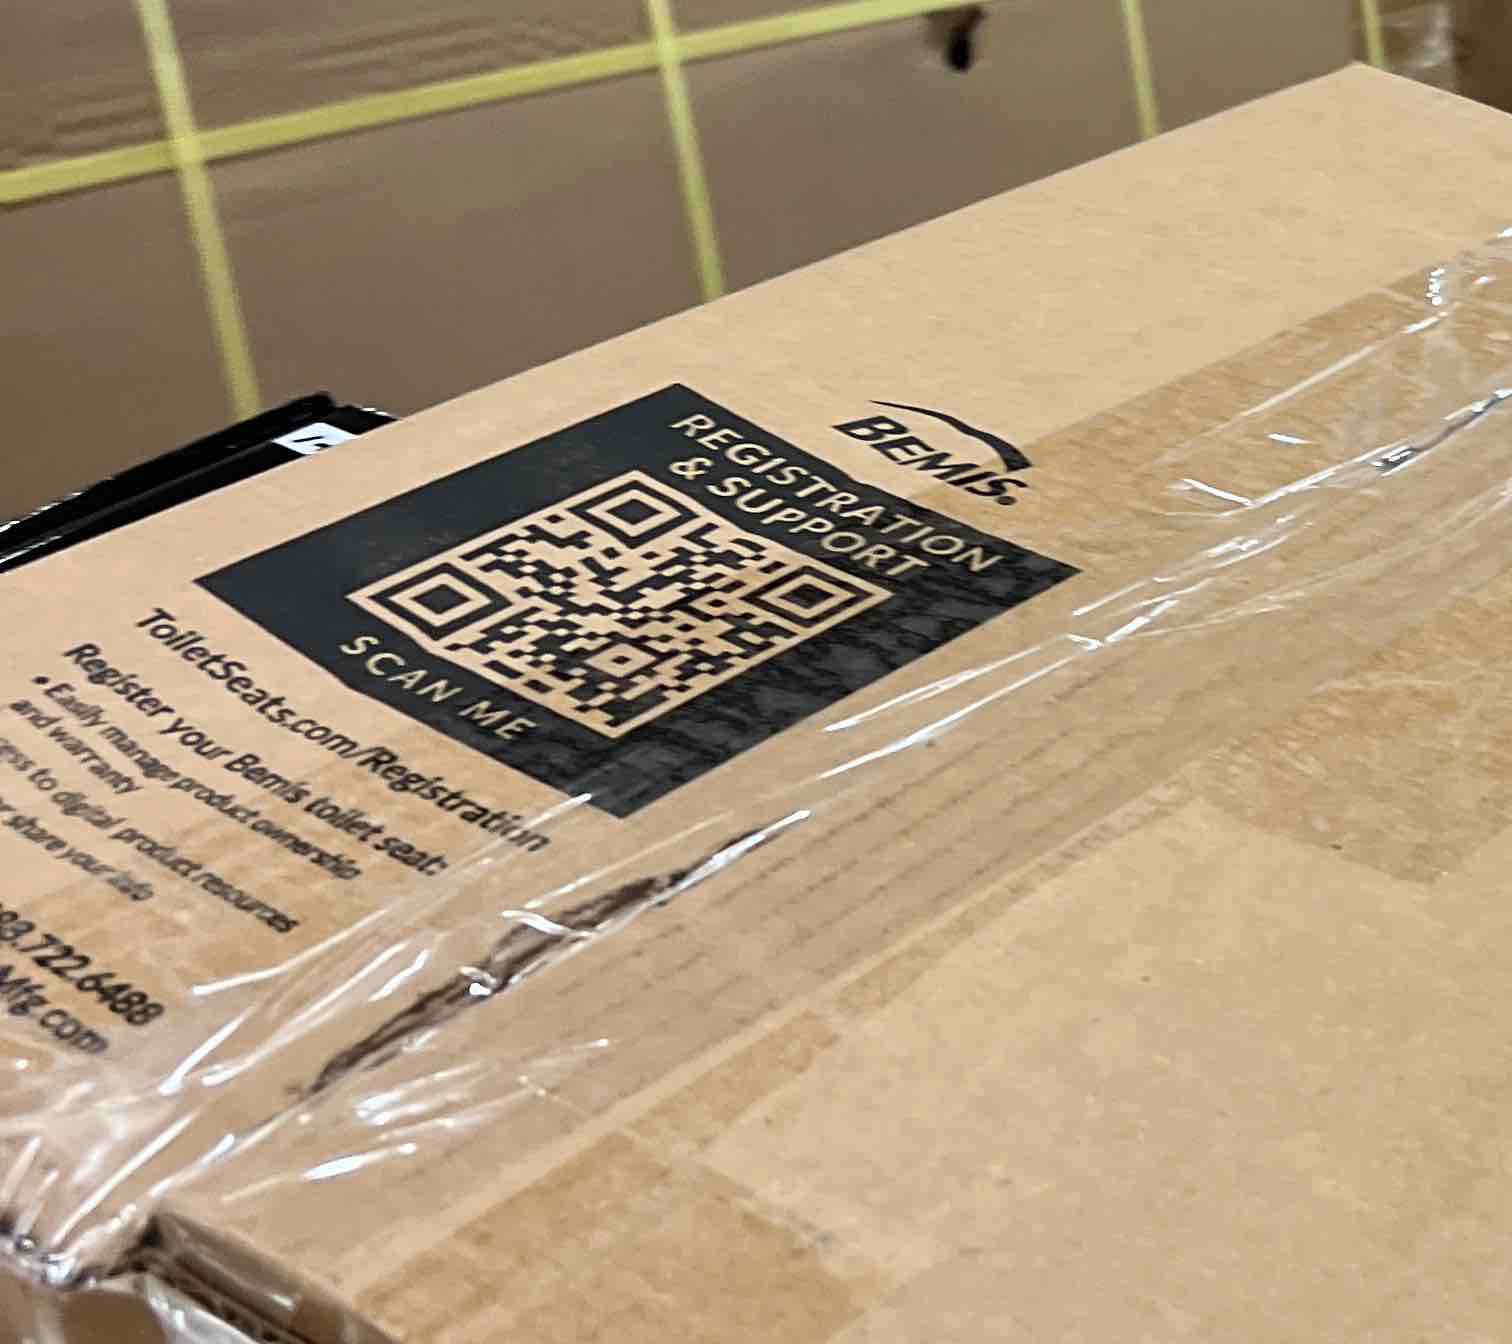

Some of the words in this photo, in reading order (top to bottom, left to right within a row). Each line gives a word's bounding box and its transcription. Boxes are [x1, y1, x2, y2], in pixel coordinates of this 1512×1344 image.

[669, 414, 1002, 573] REGISTRATION
[669, 457, 713, 481] &
[707, 477, 931, 576] SUPPORT
[832, 416, 1028, 502] BEMIS
[10, 699, 62, 729] and
[49, 725, 143, 794] warranty
[63, 643, 175, 717] Register
[158, 718, 235, 760] your
[224, 753, 311, 804] Bemis
[304, 797, 384, 842] toilet
[137, 607, 551, 852] ToiletSeats.com/Registration
[340, 636, 464, 702] SCAN
[459, 701, 538, 740] ME
[28, 767, 59, 791] to
[108, 827, 202, 877] product
[44, 683, 108, 727] Easily
[100, 725, 180, 782] manage
[168, 777, 259, 824] product
[250, 819, 361, 879] ownership
